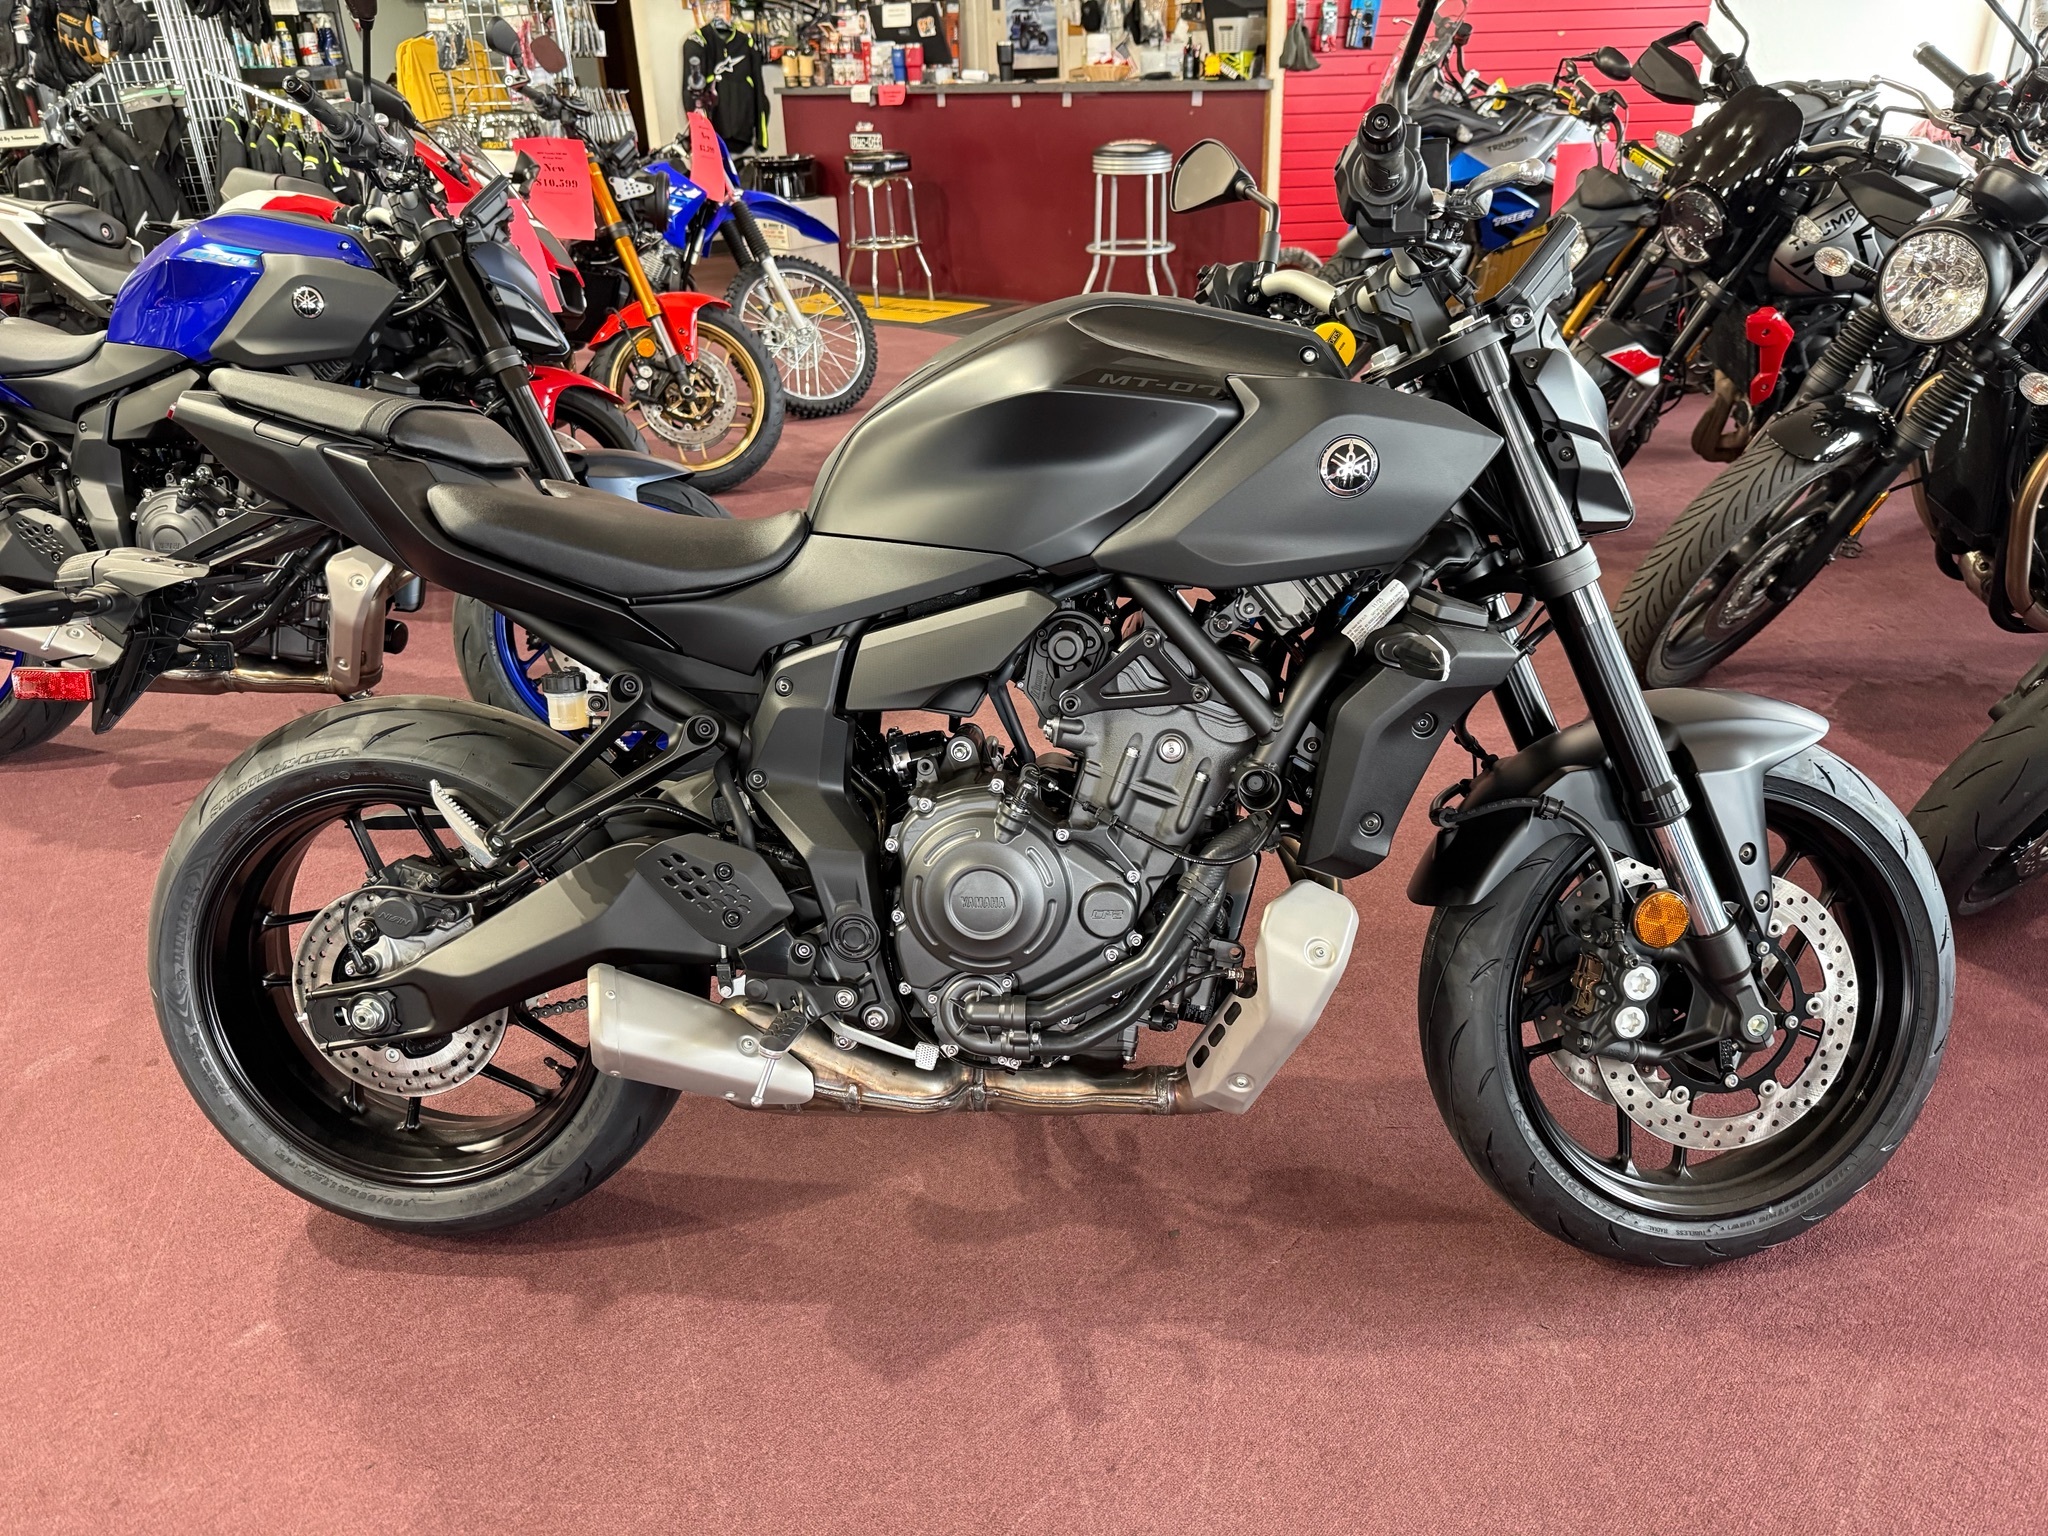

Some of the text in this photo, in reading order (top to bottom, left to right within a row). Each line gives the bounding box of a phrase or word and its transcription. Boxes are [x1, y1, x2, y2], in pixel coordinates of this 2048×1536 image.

[1487, 137, 1528, 152] TRIUMPH
[543, 163, 565, 172] New
[1492, 208, 1535, 227] TIGER
[1098, 373, 1222, 397] MT-07
[961, 896, 1007, 909] YAMAHA
[1649, 1225, 1706, 1237] TUBELESS RADIAL
